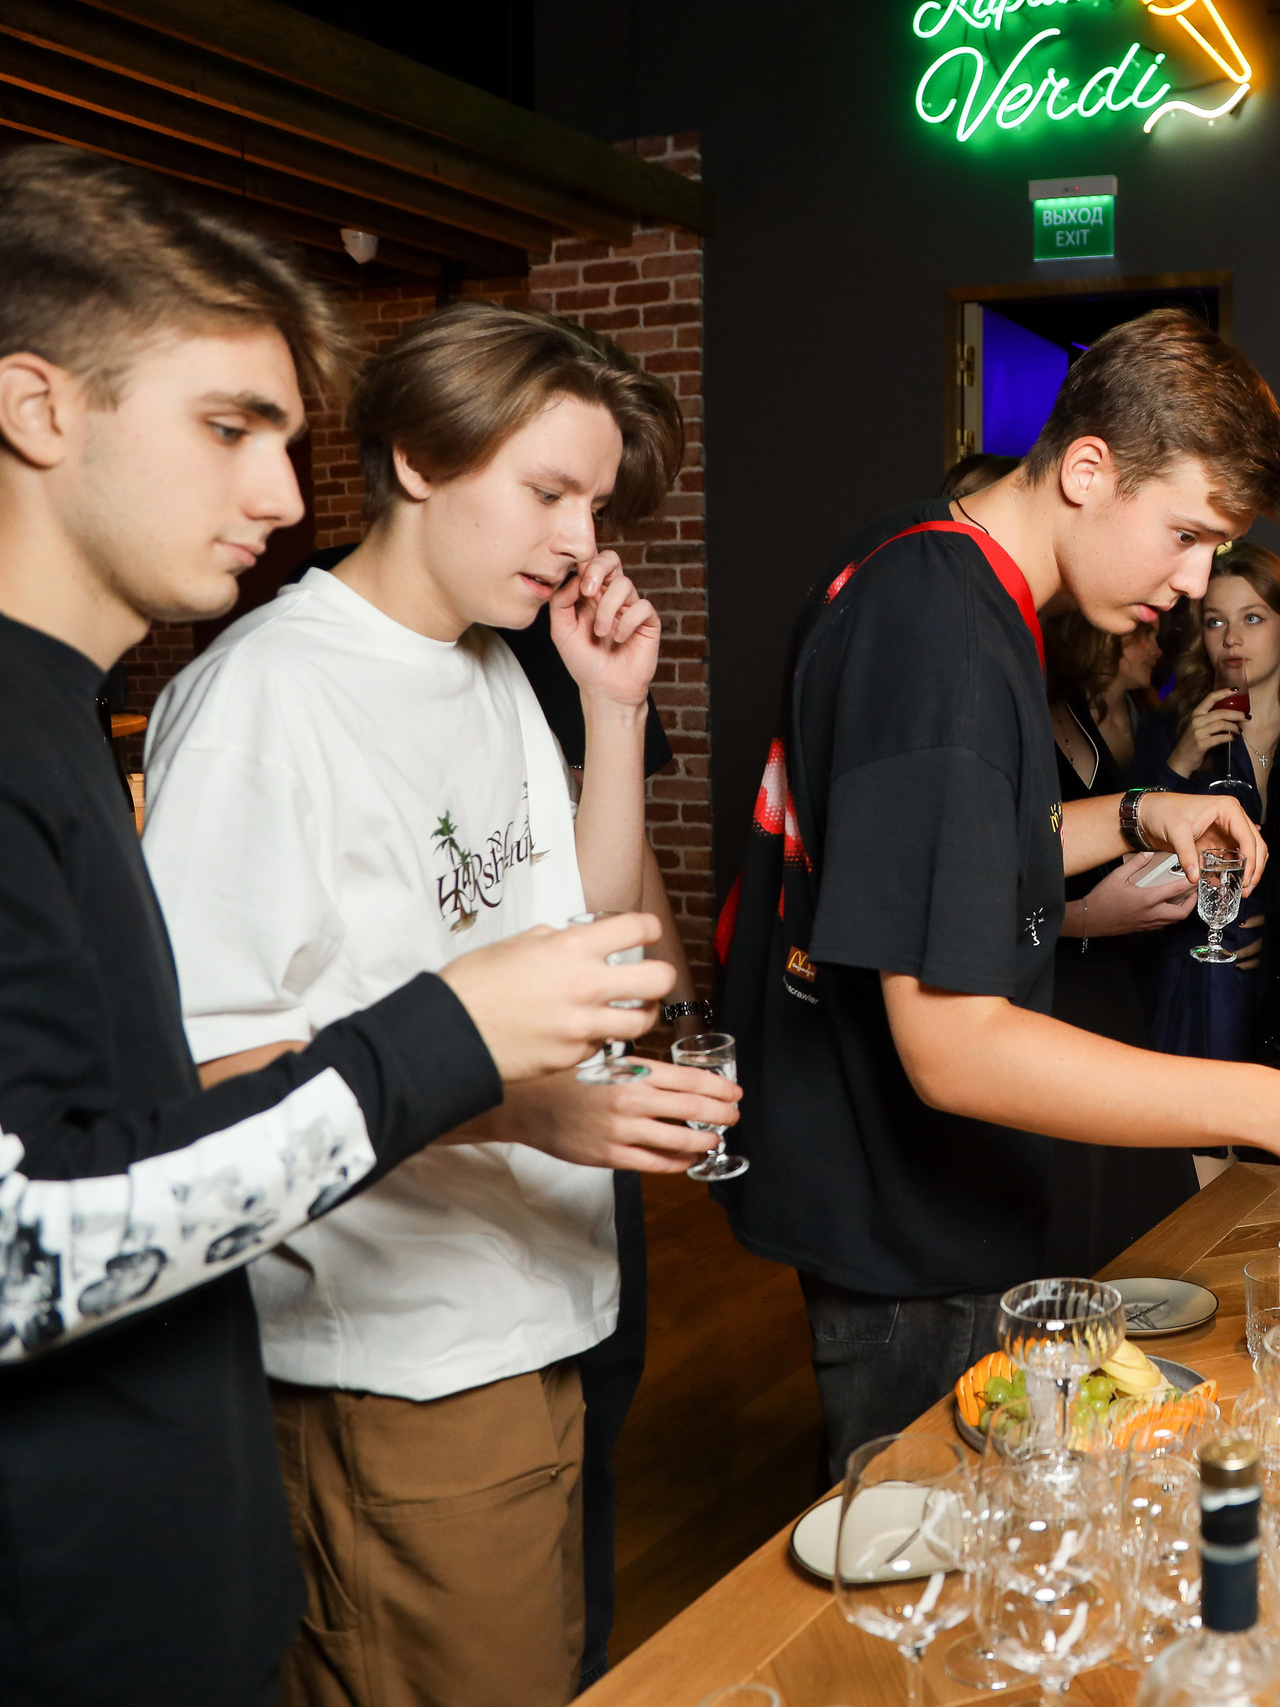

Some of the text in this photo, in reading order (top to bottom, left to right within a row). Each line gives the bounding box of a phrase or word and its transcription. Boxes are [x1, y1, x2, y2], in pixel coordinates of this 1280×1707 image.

[915, 27, 1171, 143] Verdi
[1042, 206, 1104, 227] ВЫХОД
[1055, 229, 1090, 247] EXIT
